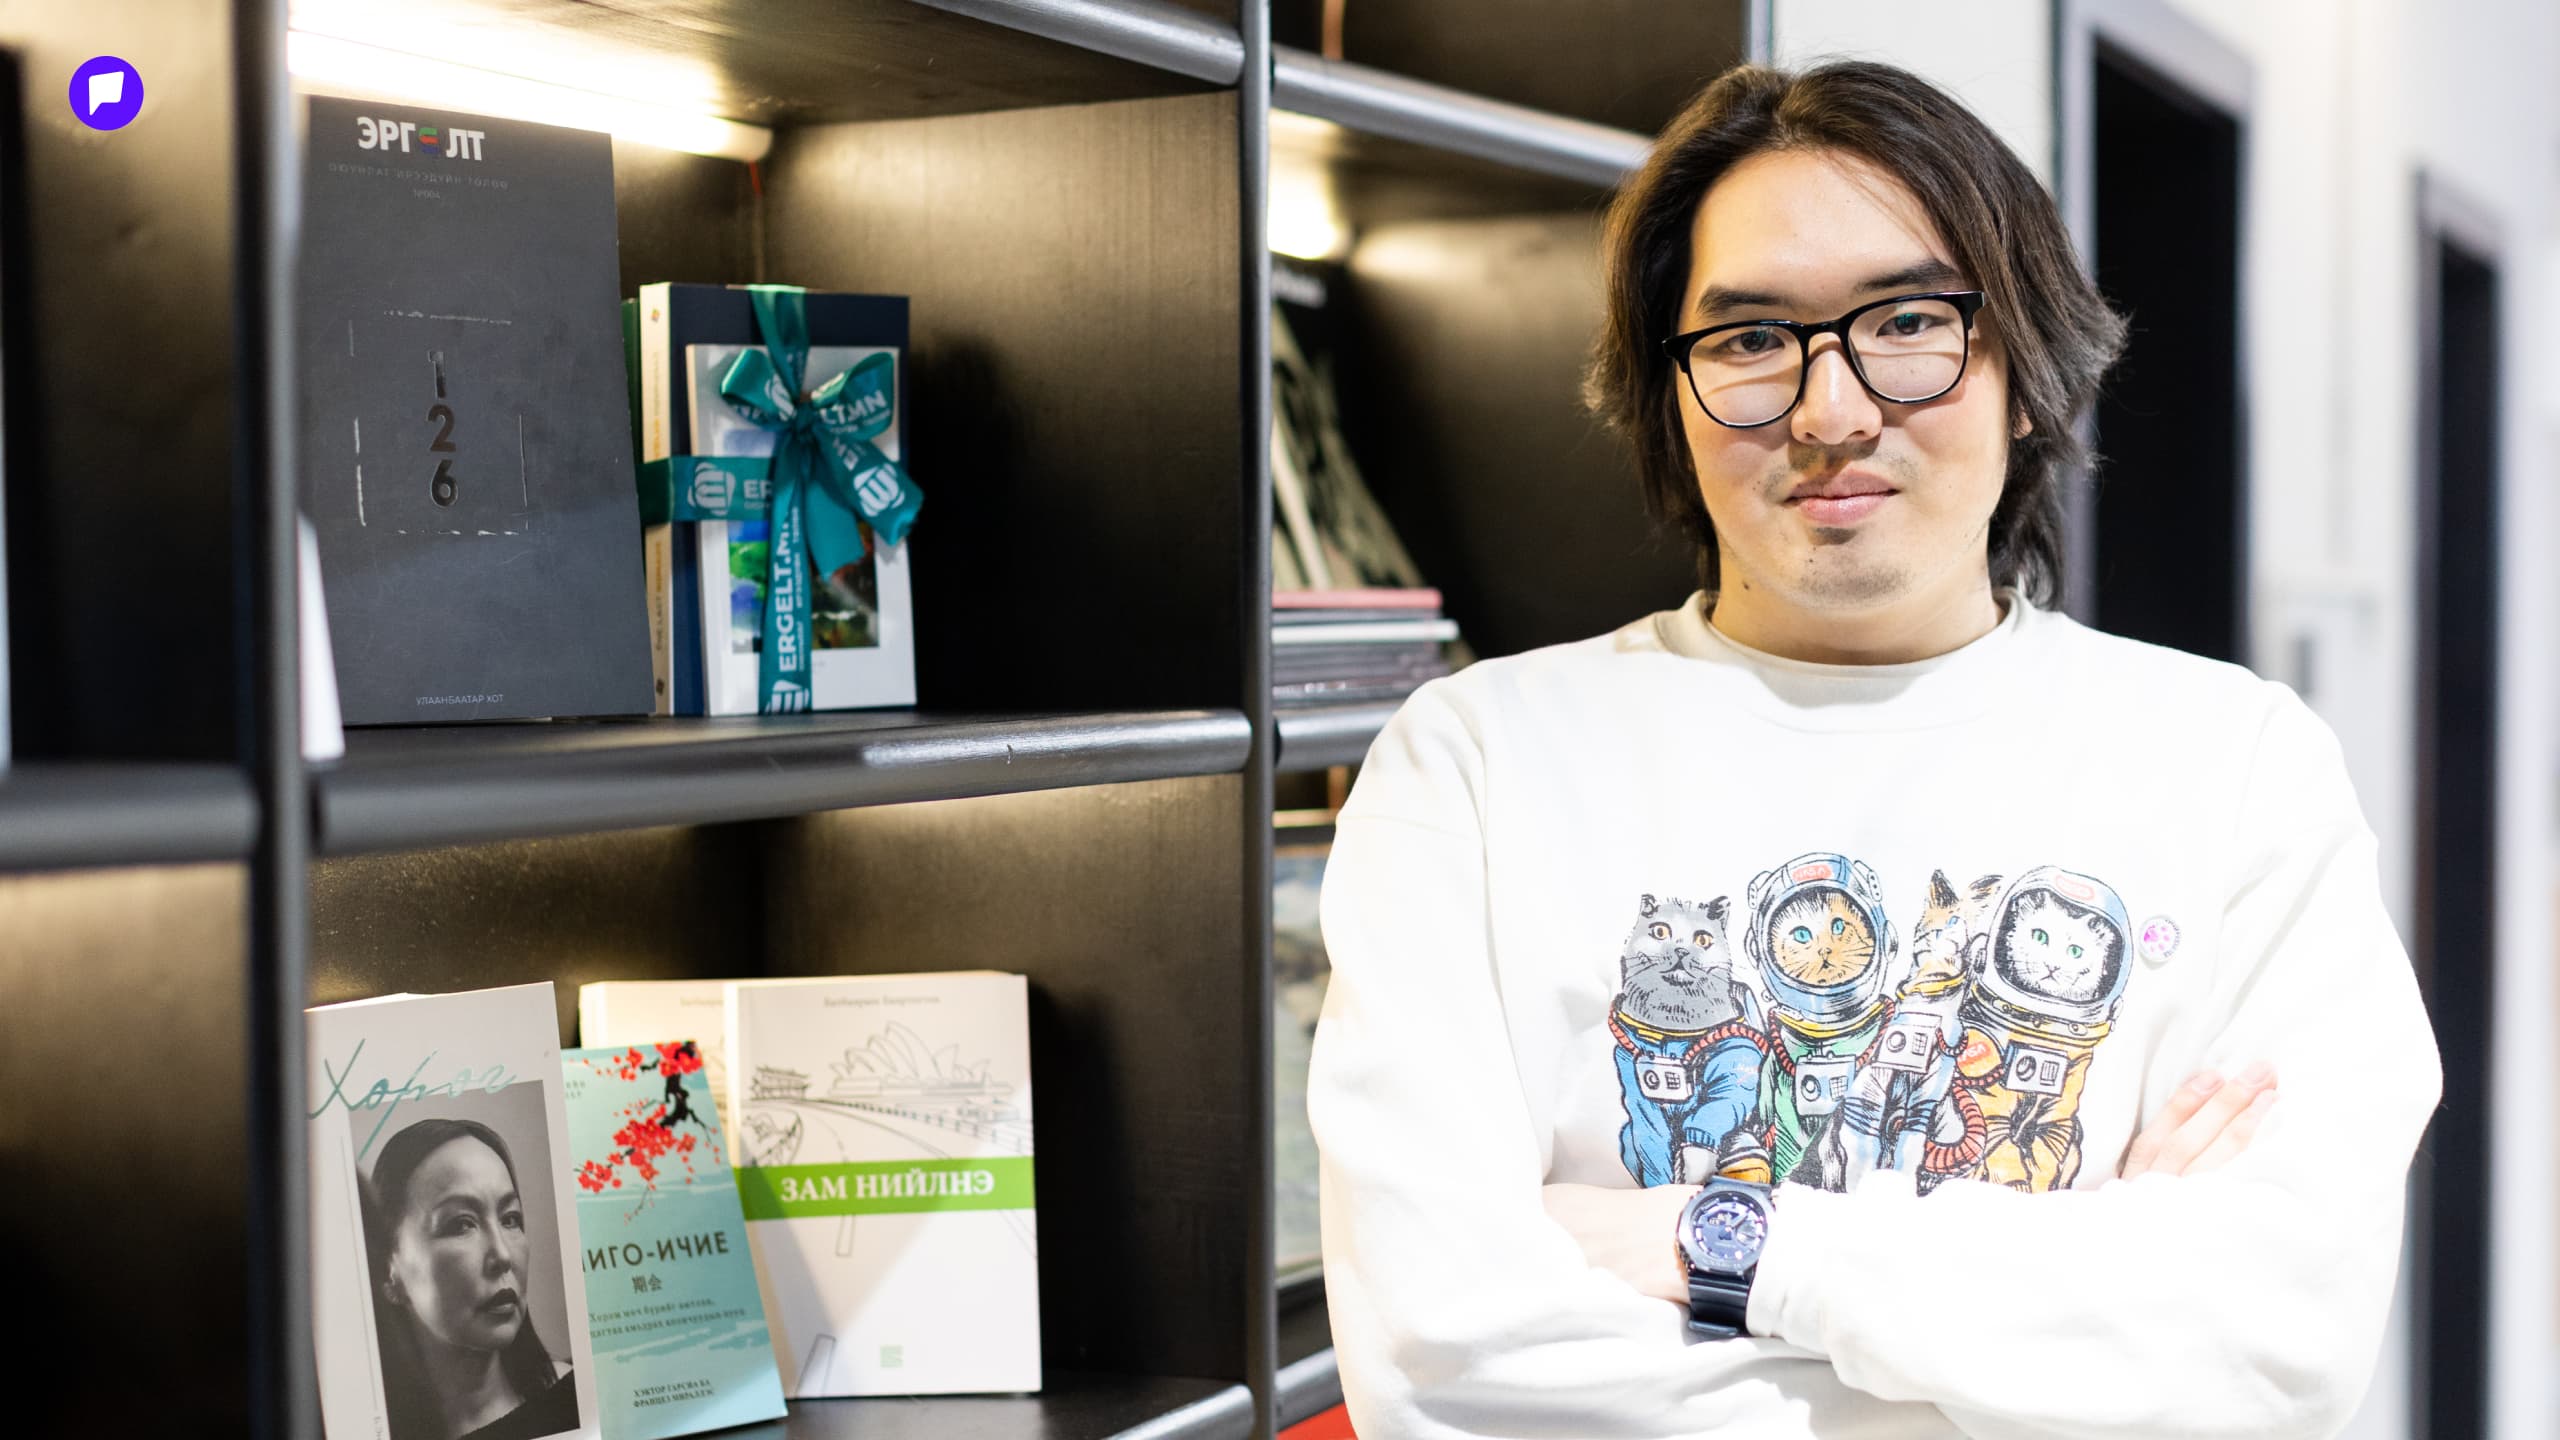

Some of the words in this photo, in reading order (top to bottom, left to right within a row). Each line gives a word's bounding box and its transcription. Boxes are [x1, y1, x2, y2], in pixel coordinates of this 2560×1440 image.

[773, 521, 797, 672] ERGELT.M
[780, 1174, 847, 1203] ЗАМ
[855, 1169, 996, 1199] НИЙЛНЭ
[582, 1231, 729, 1273] ИГО-ИЧИЕ
